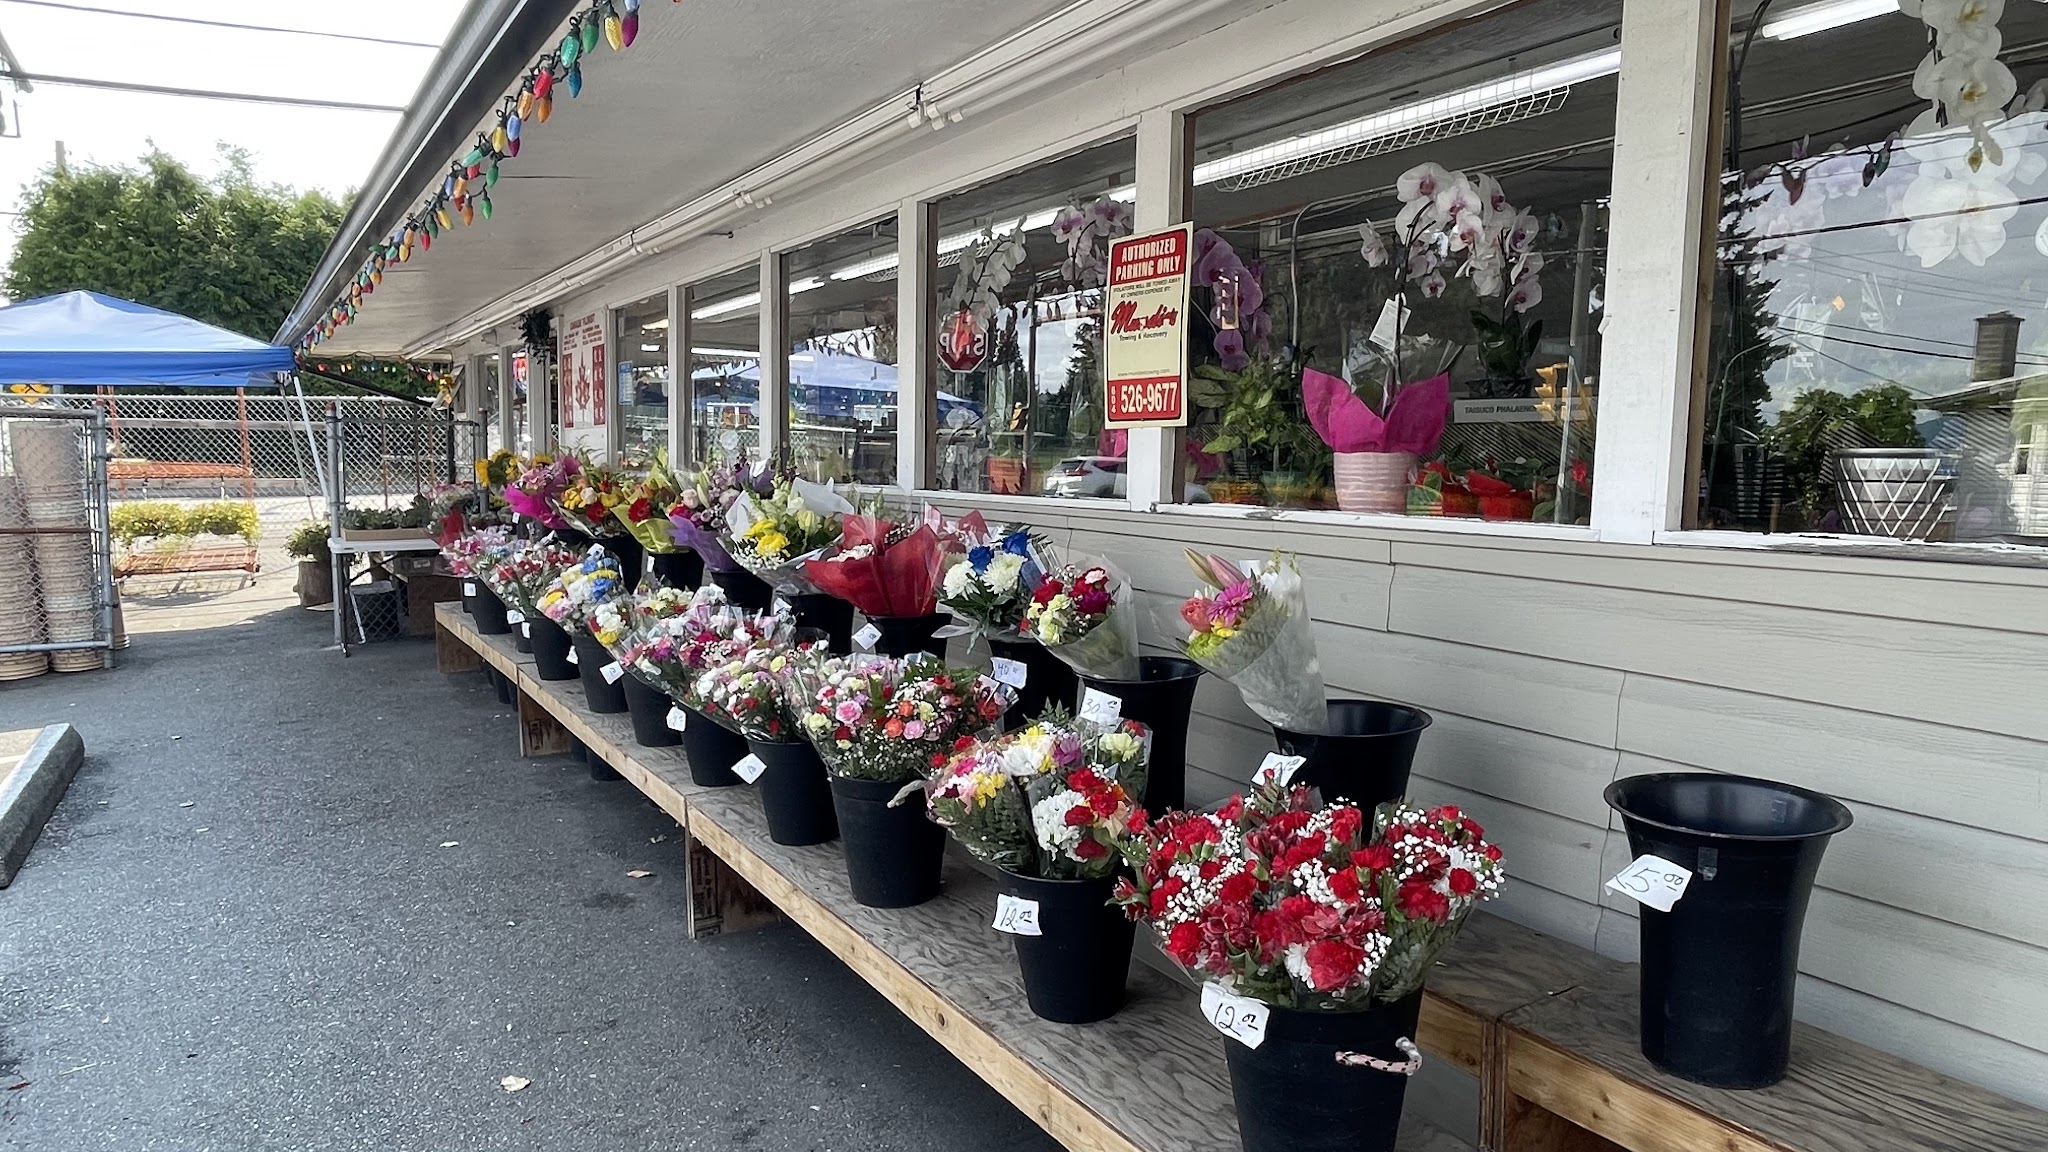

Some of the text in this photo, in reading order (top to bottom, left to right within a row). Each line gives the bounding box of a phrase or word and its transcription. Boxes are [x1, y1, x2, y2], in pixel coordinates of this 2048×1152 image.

[1121, 237, 1176, 263] AUTHORIZED
[1115, 255, 1181, 282] PARKING ONLY
[1119, 334, 1137, 342] Towing
[1143, 331, 1168, 340] Recovery
[1120, 381, 1178, 414] 526-9677
